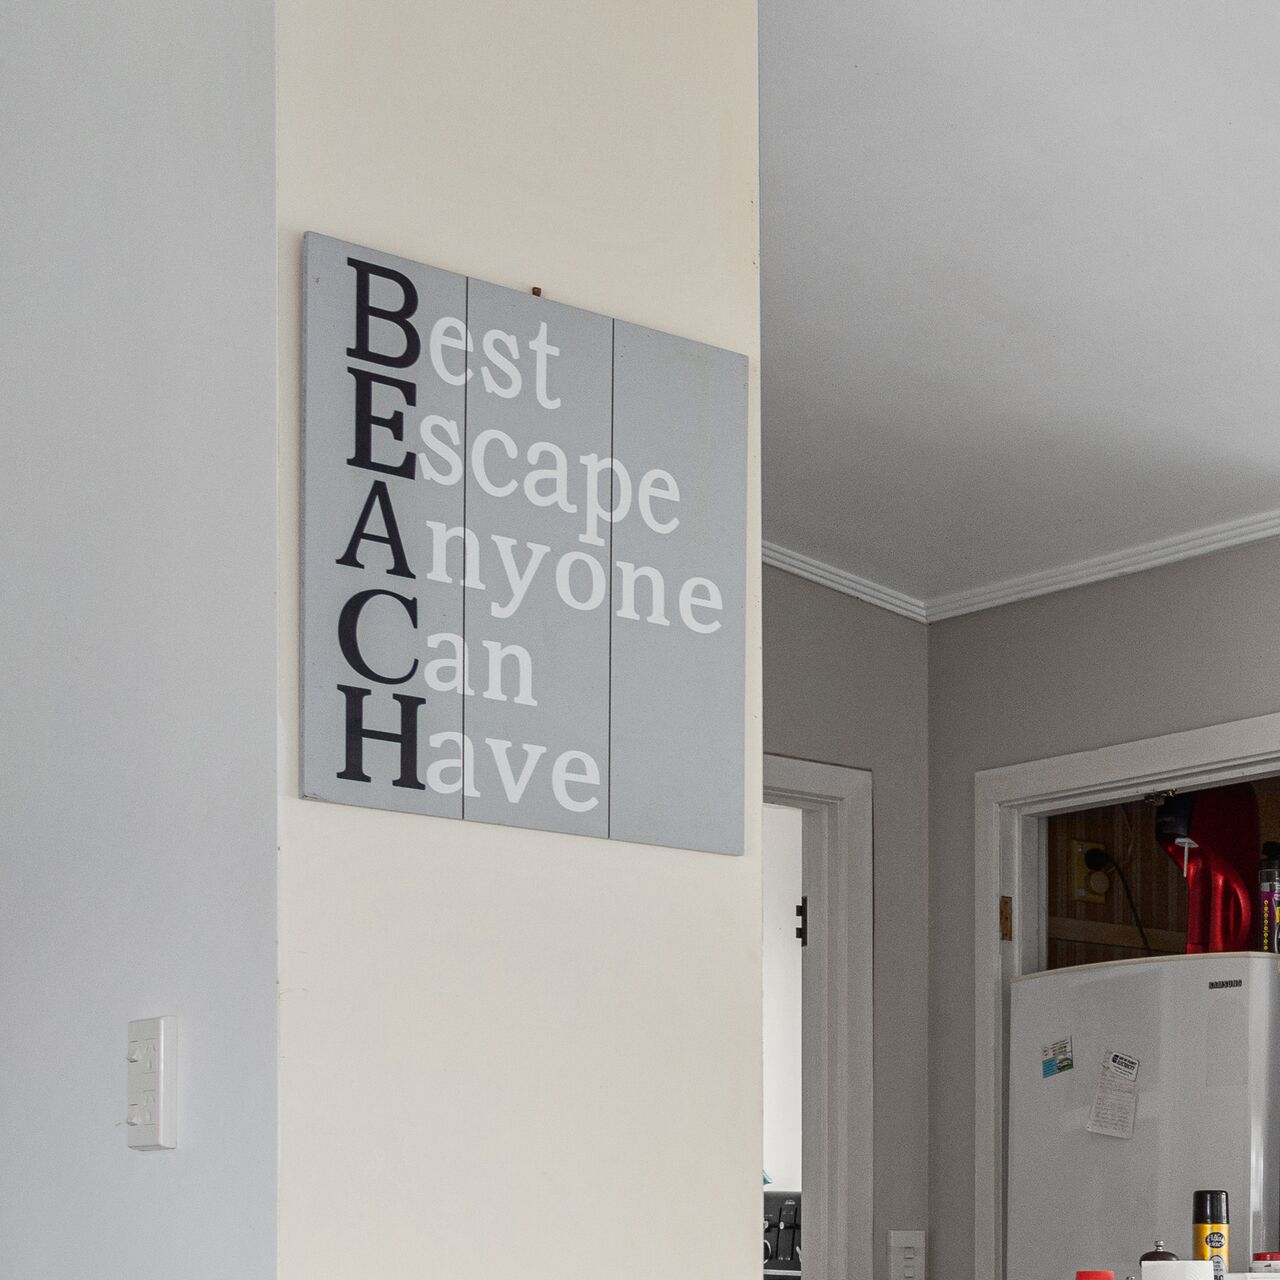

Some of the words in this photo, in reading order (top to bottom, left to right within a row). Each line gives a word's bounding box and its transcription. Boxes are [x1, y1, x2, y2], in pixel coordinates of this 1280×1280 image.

[346, 256, 562, 410] Best
[346, 366, 681, 547] Escape
[335, 479, 724, 635] Anyone
[337, 588, 538, 707] Can
[335, 683, 601, 813] Have
